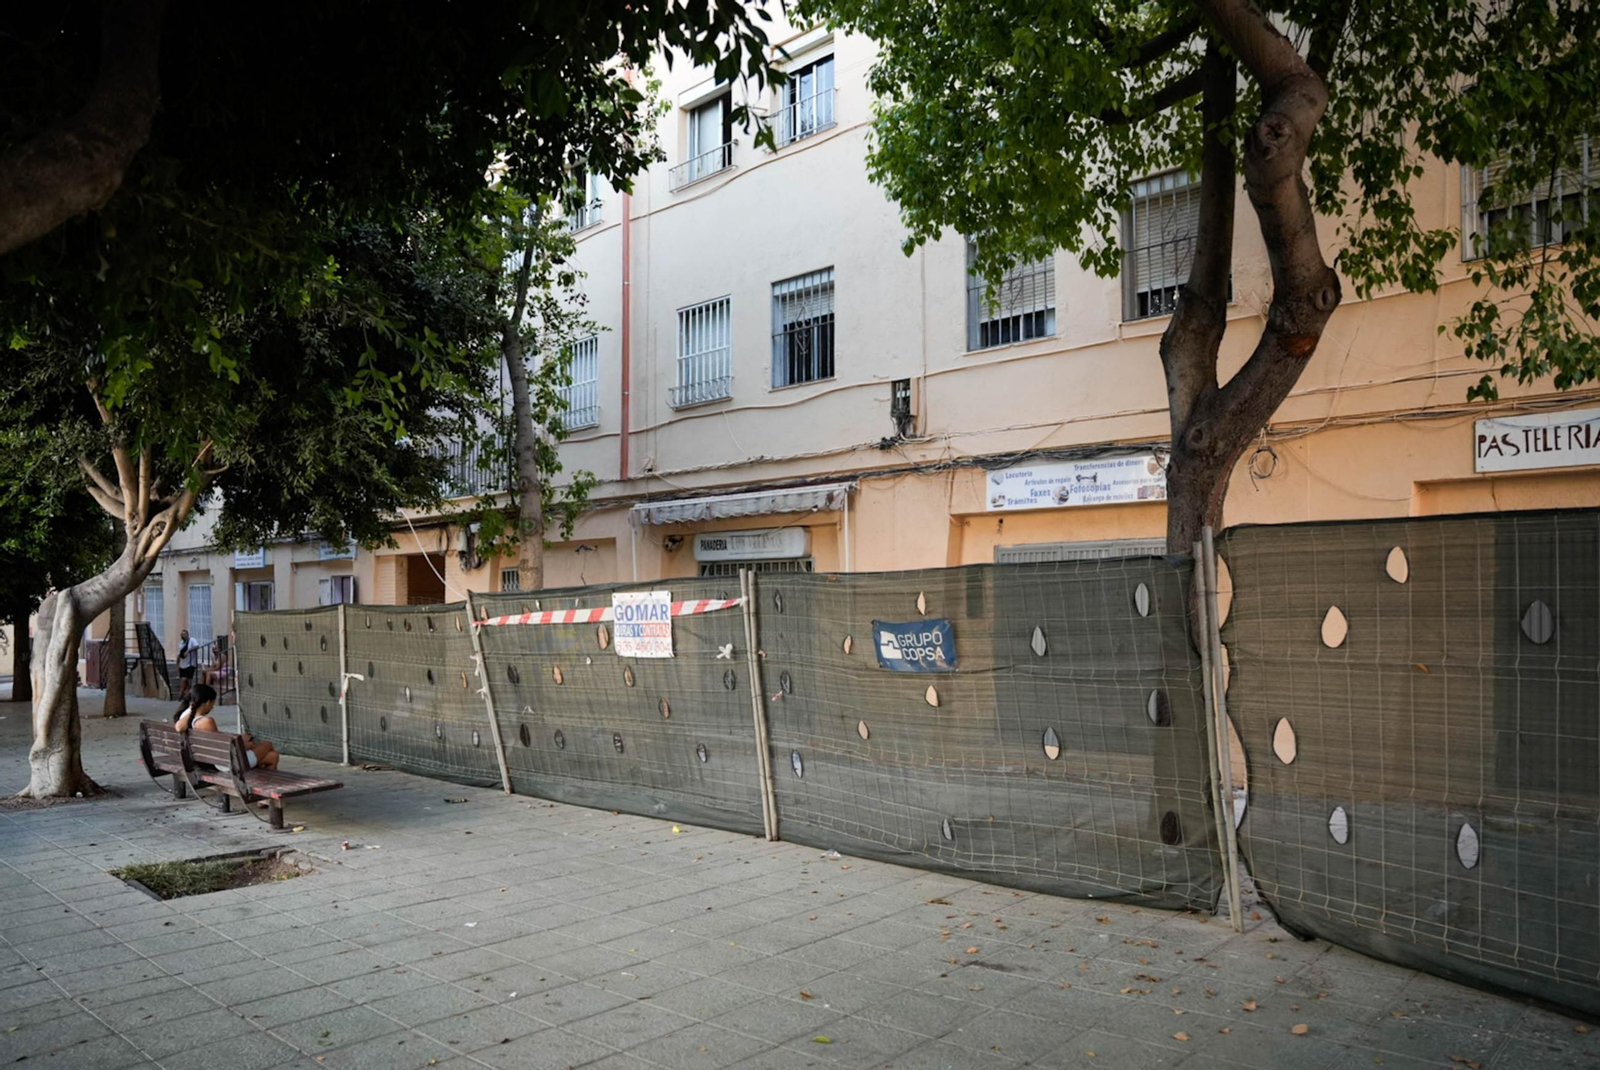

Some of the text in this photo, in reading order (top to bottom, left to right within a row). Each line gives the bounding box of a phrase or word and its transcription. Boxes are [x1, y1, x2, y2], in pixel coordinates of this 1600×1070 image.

[1005, 471, 1033, 479] Locutorio
[1030, 489, 1051, 497] Faxes
[1070, 483, 1111, 494] Fotocopias
[1007, 497, 1038, 505] Trámites
[700, 539, 727, 552] PANADERIA
[614, 603, 669, 622] GOMAR
[897, 631, 943, 647] GRUPO
[902, 646, 946, 661] COPSA
